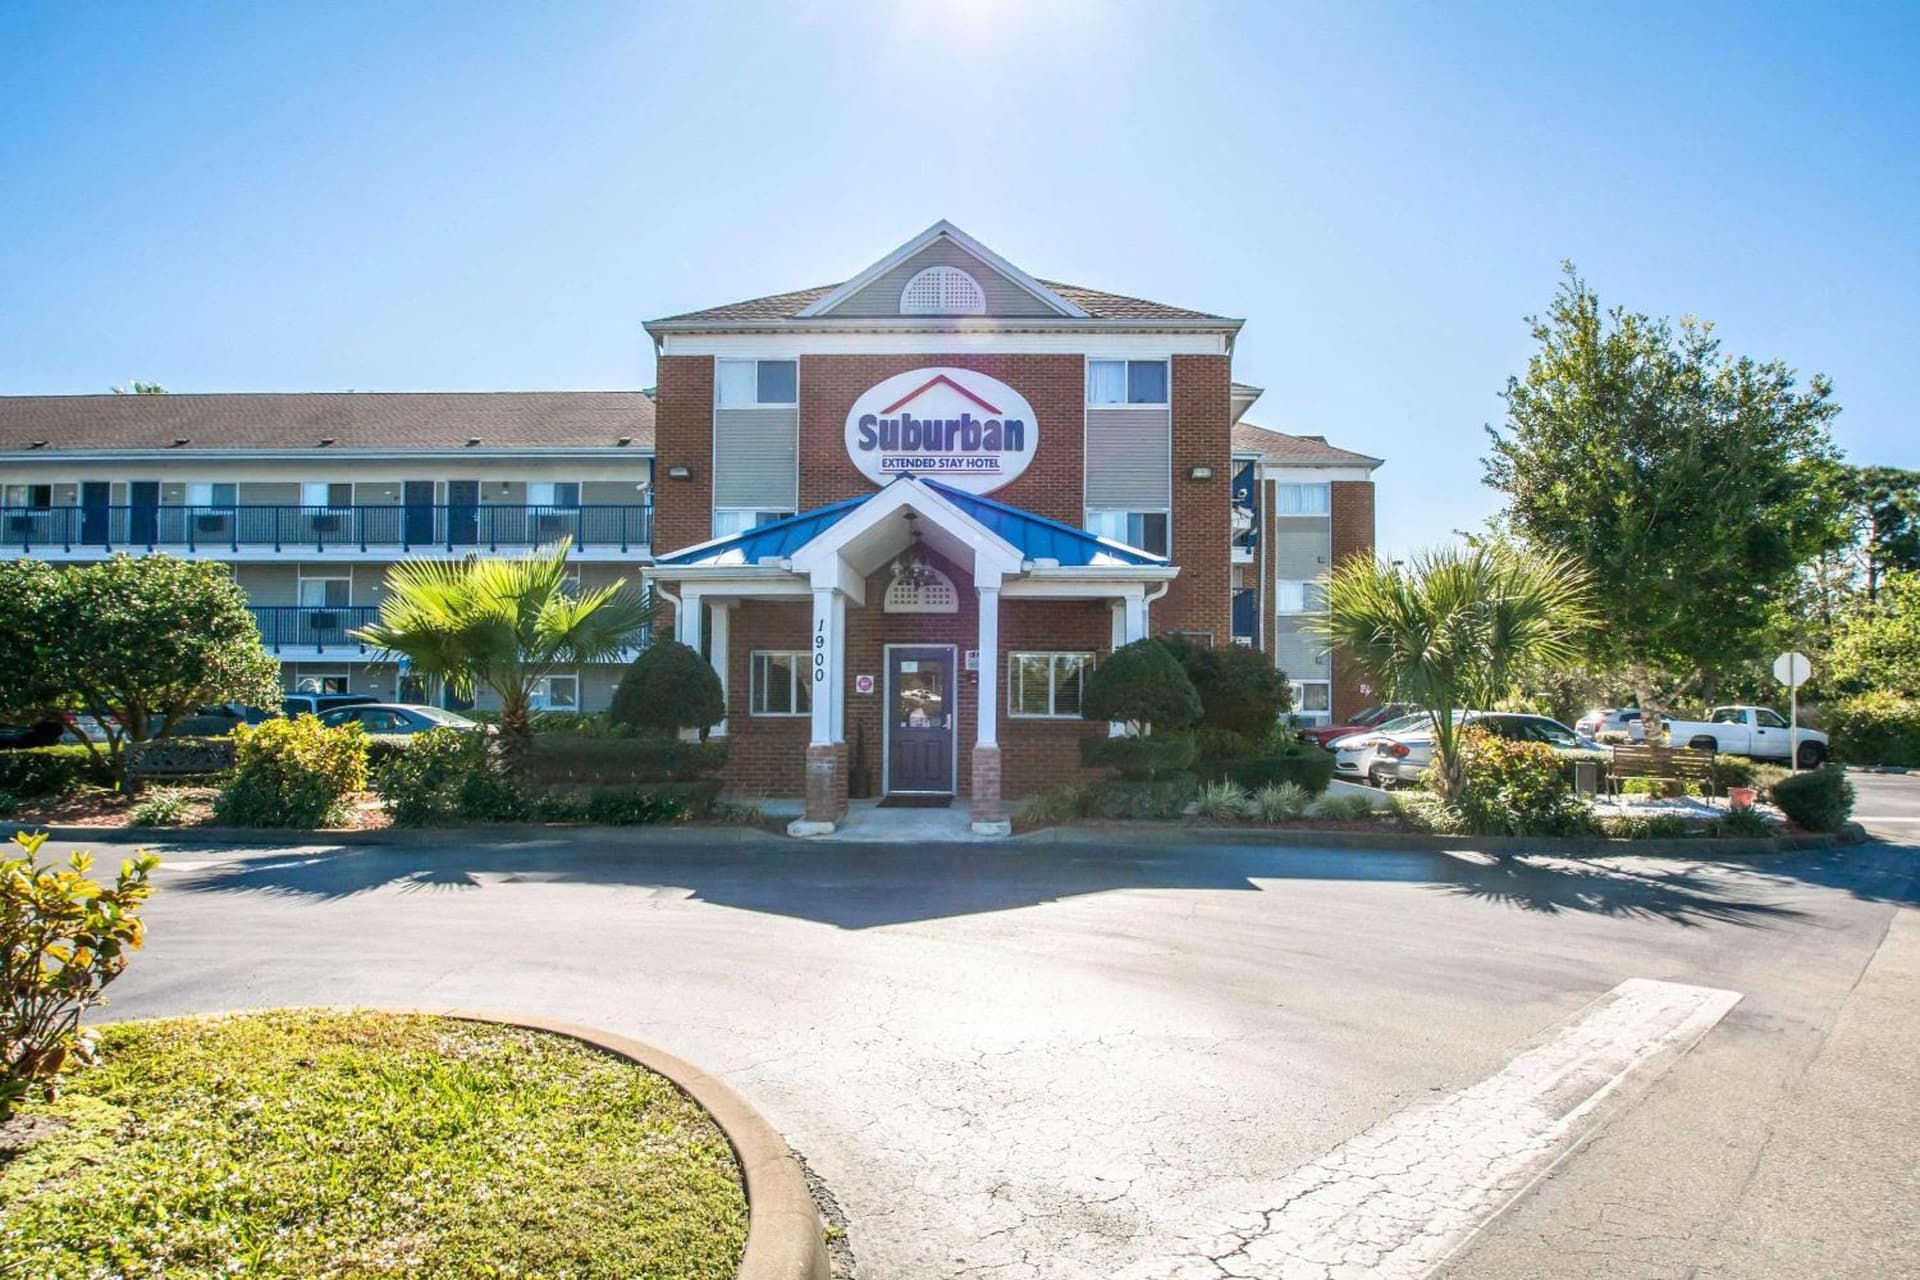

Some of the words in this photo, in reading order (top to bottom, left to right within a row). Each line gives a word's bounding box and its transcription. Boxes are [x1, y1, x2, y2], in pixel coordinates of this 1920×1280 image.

[858, 413, 1025, 452] Suburban
[882, 458, 936, 468] EXTENDED
[938, 458, 964, 468] STAY
[966, 458, 1000, 468] HOTEL
[815, 618, 824, 682] 1900
